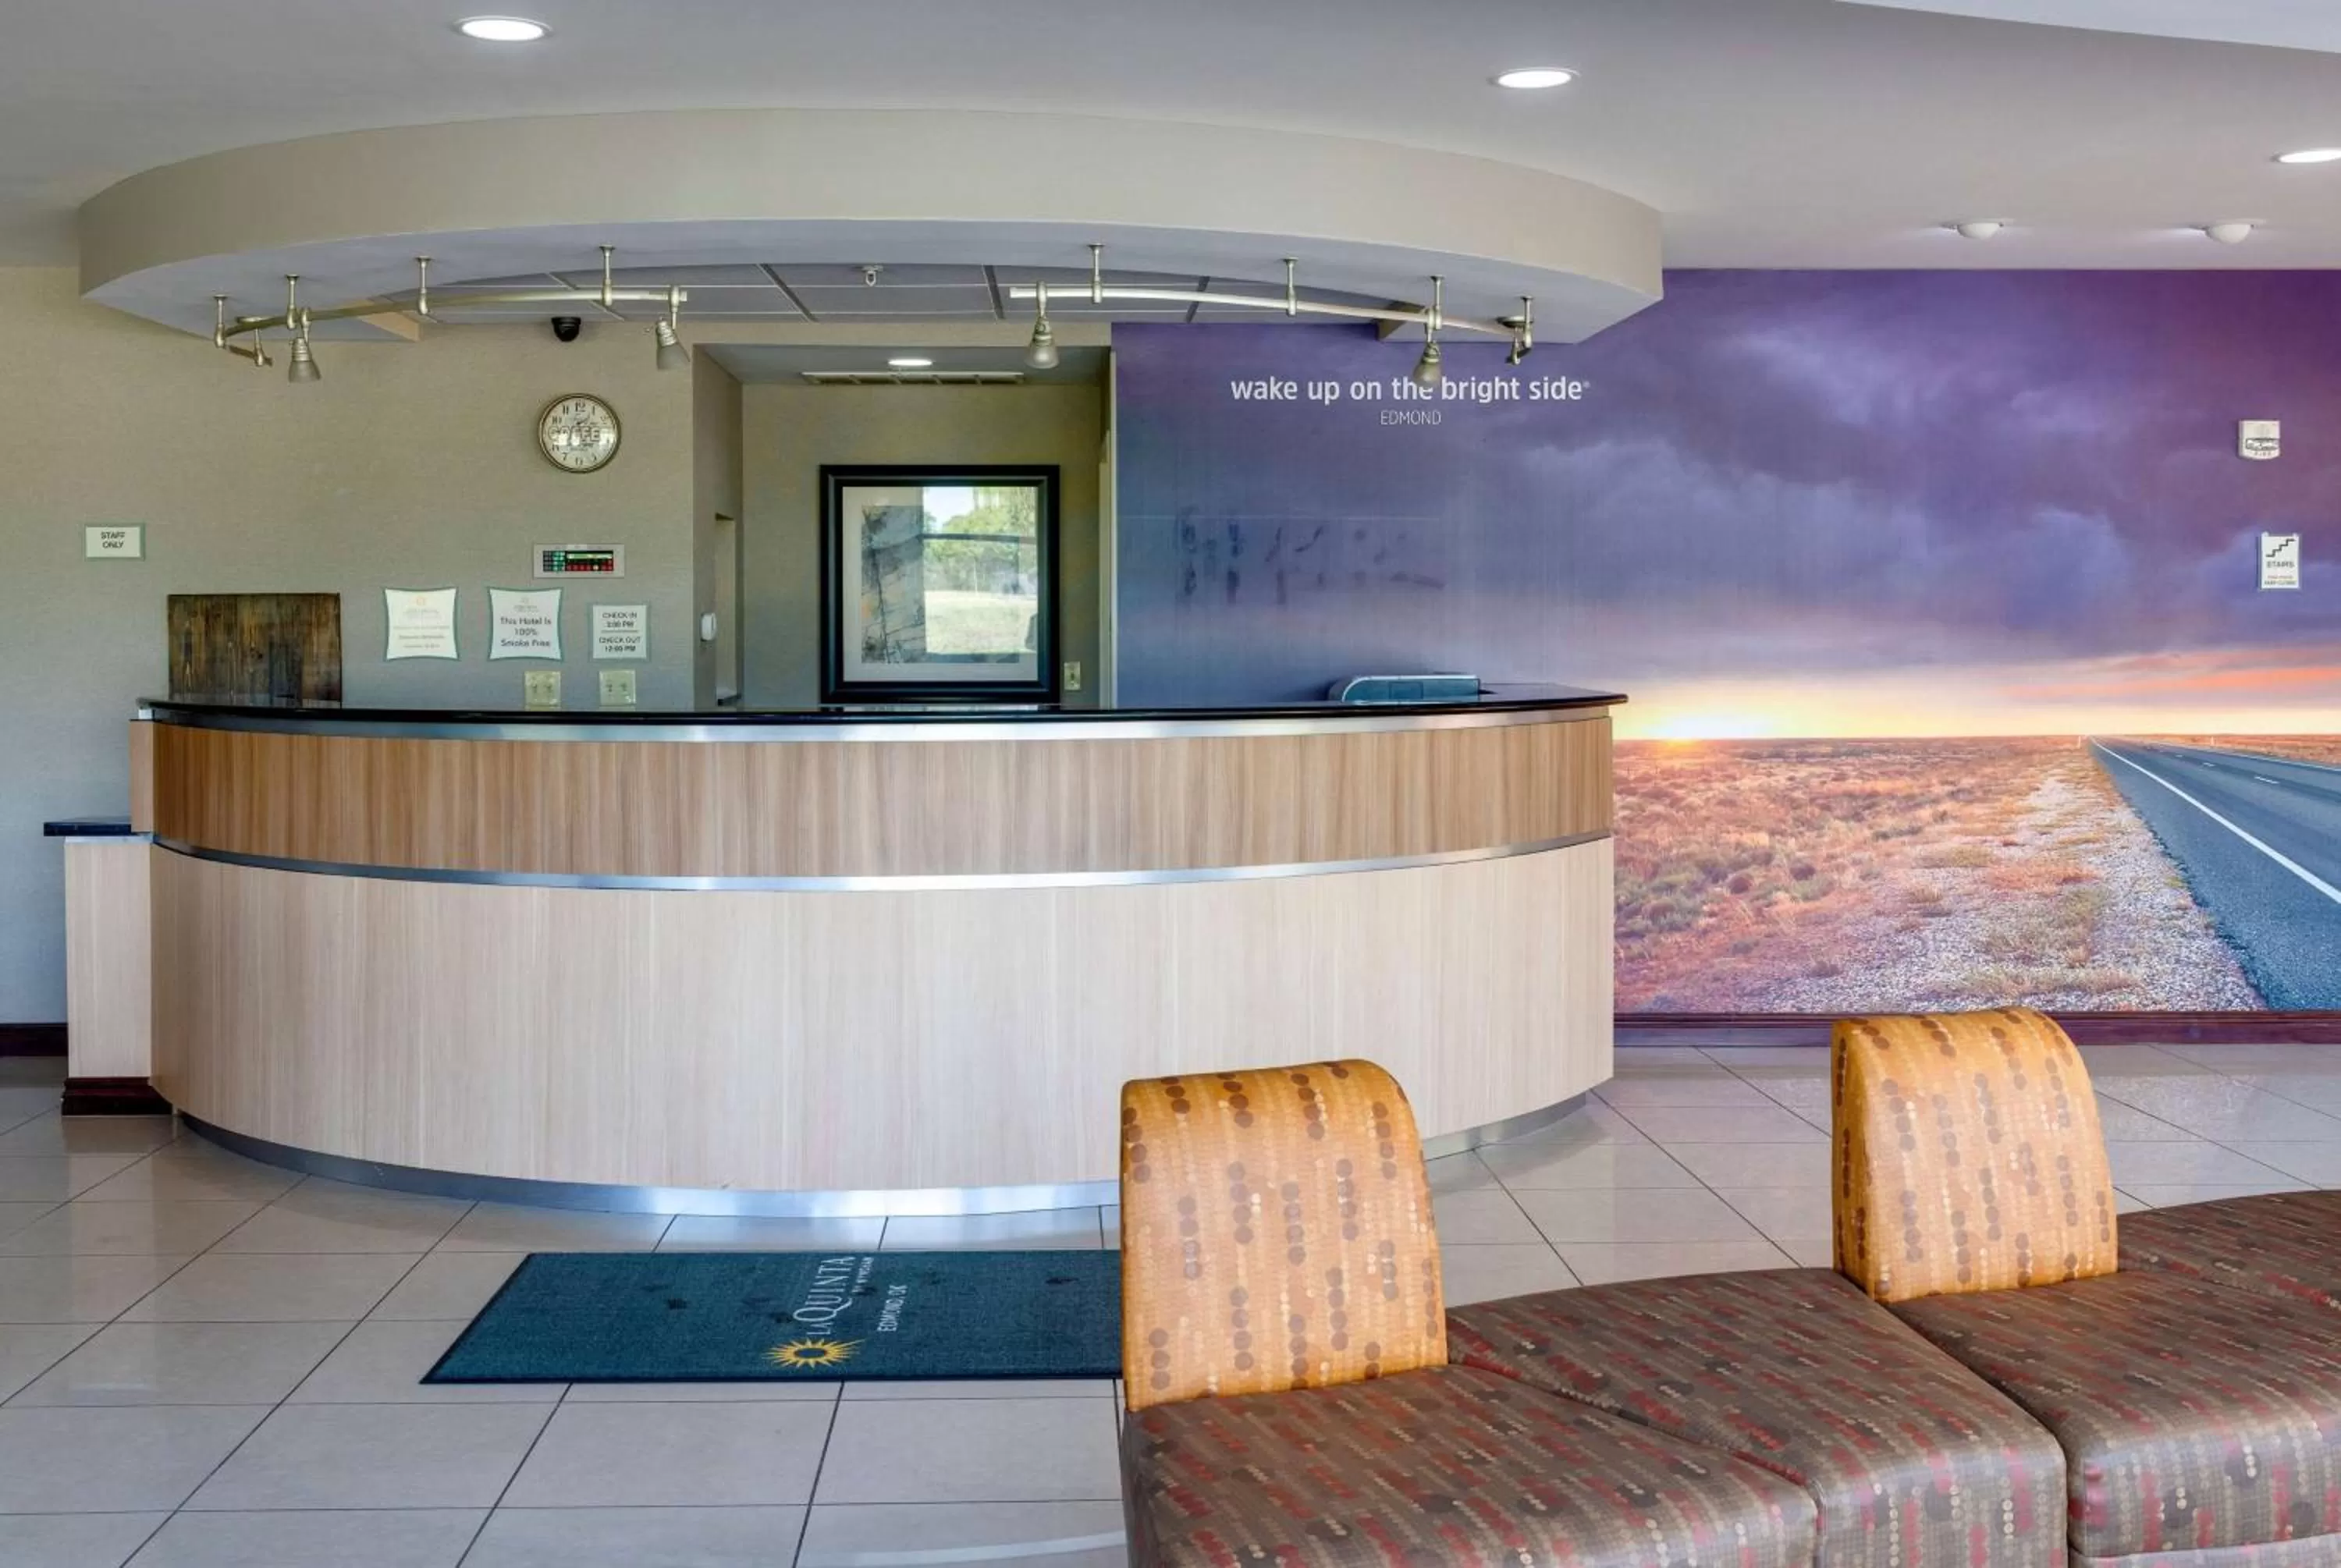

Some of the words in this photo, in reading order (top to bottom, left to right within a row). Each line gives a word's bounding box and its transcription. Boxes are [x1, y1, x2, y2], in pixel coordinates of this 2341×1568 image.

[1231, 376, 1298, 400] wake
[1308, 381, 1340, 406] up
[1349, 381, 1382, 400] on
[1391, 377, 1433, 400] the
[1441, 377, 1520, 403] bright
[1380, 410, 1442, 425] EDMOND
[101, 531, 126, 540] STAFF
[101, 541, 124, 549] ONLY
[500, 616, 517, 625] This
[519, 616, 542, 625] Hotel
[514, 626, 538, 636] 100%
[500, 638, 530, 647] Smoke
